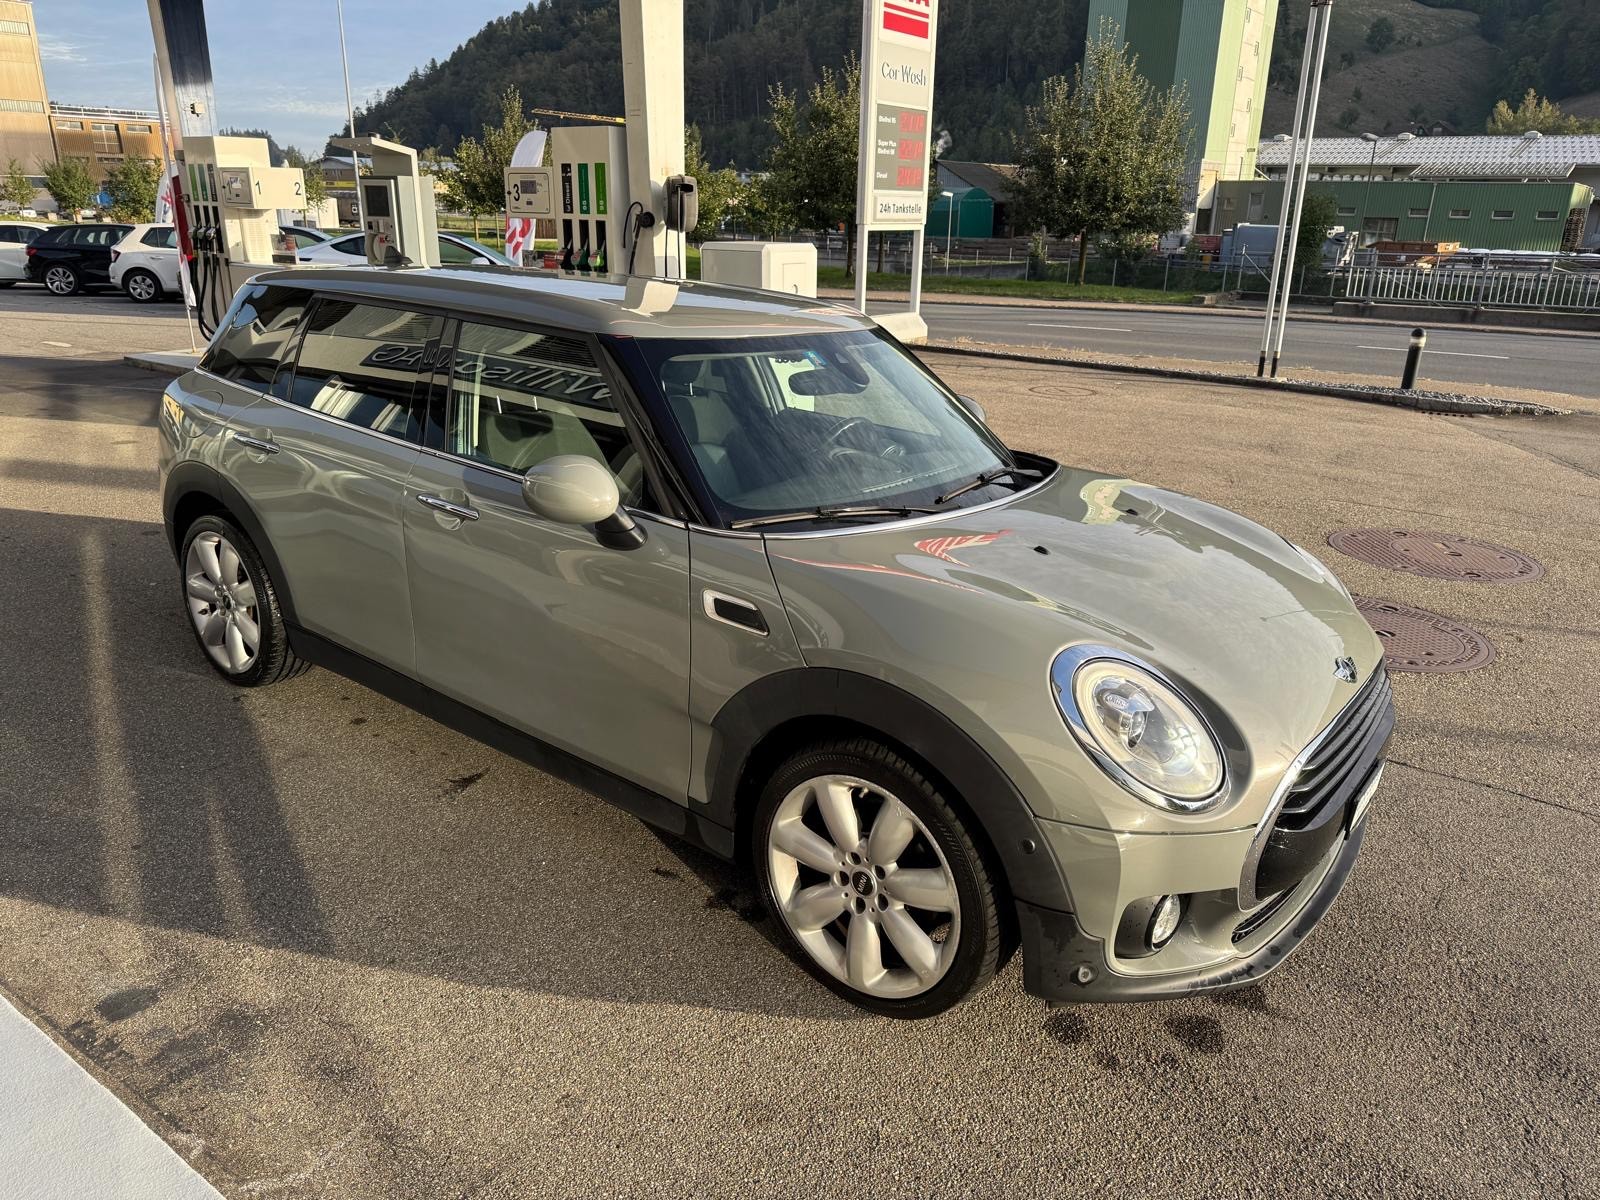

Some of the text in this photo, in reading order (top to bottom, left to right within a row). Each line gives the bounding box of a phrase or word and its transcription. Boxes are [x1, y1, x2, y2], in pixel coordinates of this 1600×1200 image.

[255, 180, 261, 195] 1
[294, 181, 302, 196] 2
[513, 183, 520, 202] 3
[879, 202, 922, 214] 24h Tankstelle
